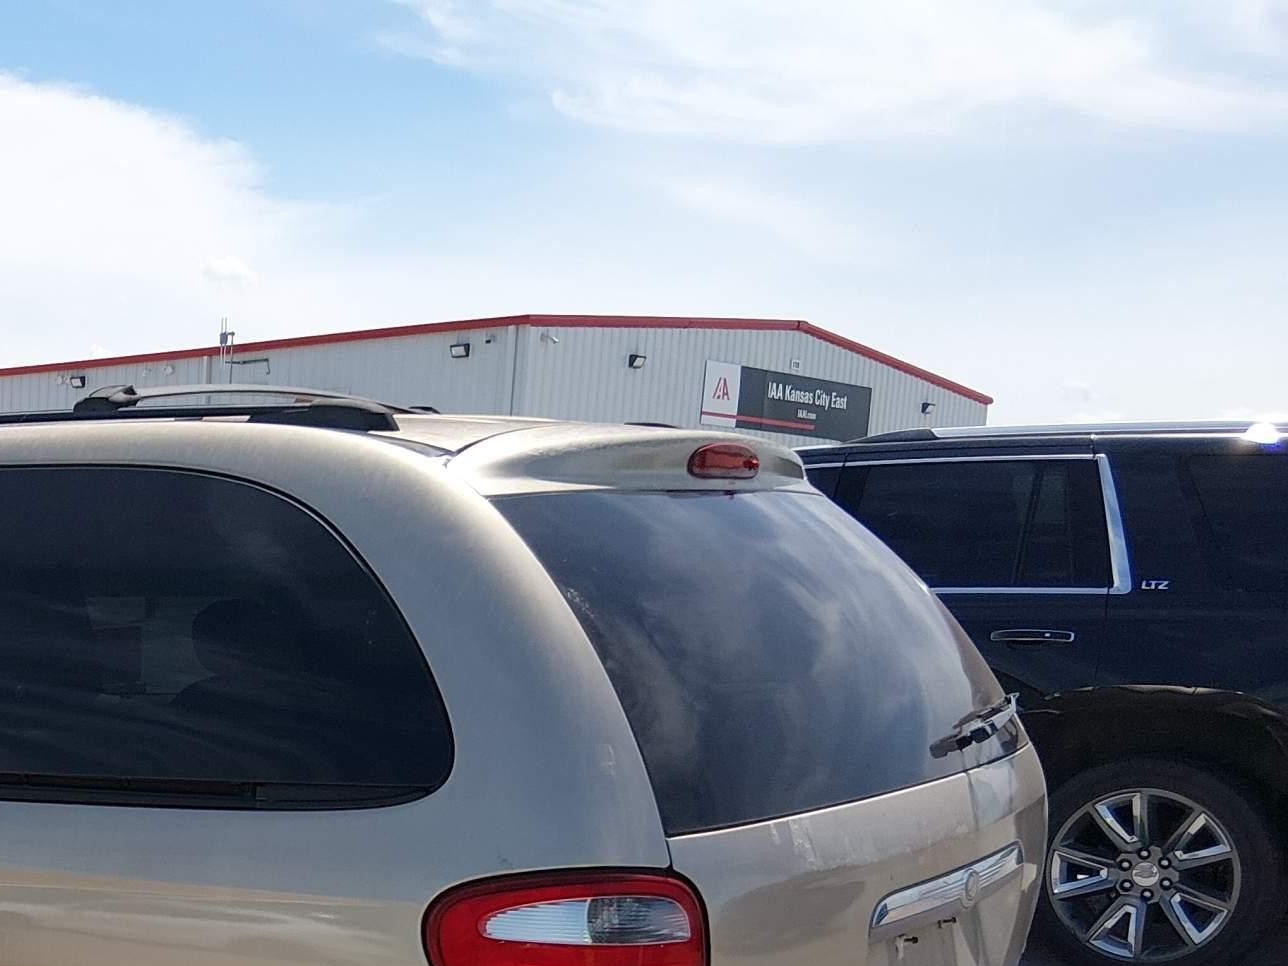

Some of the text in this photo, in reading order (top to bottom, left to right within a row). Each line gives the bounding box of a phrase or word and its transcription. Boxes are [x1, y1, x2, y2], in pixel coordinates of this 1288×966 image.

[767, 381, 847, 411] IAA Kansas City East
[1141, 580, 1169, 590] LTZ
